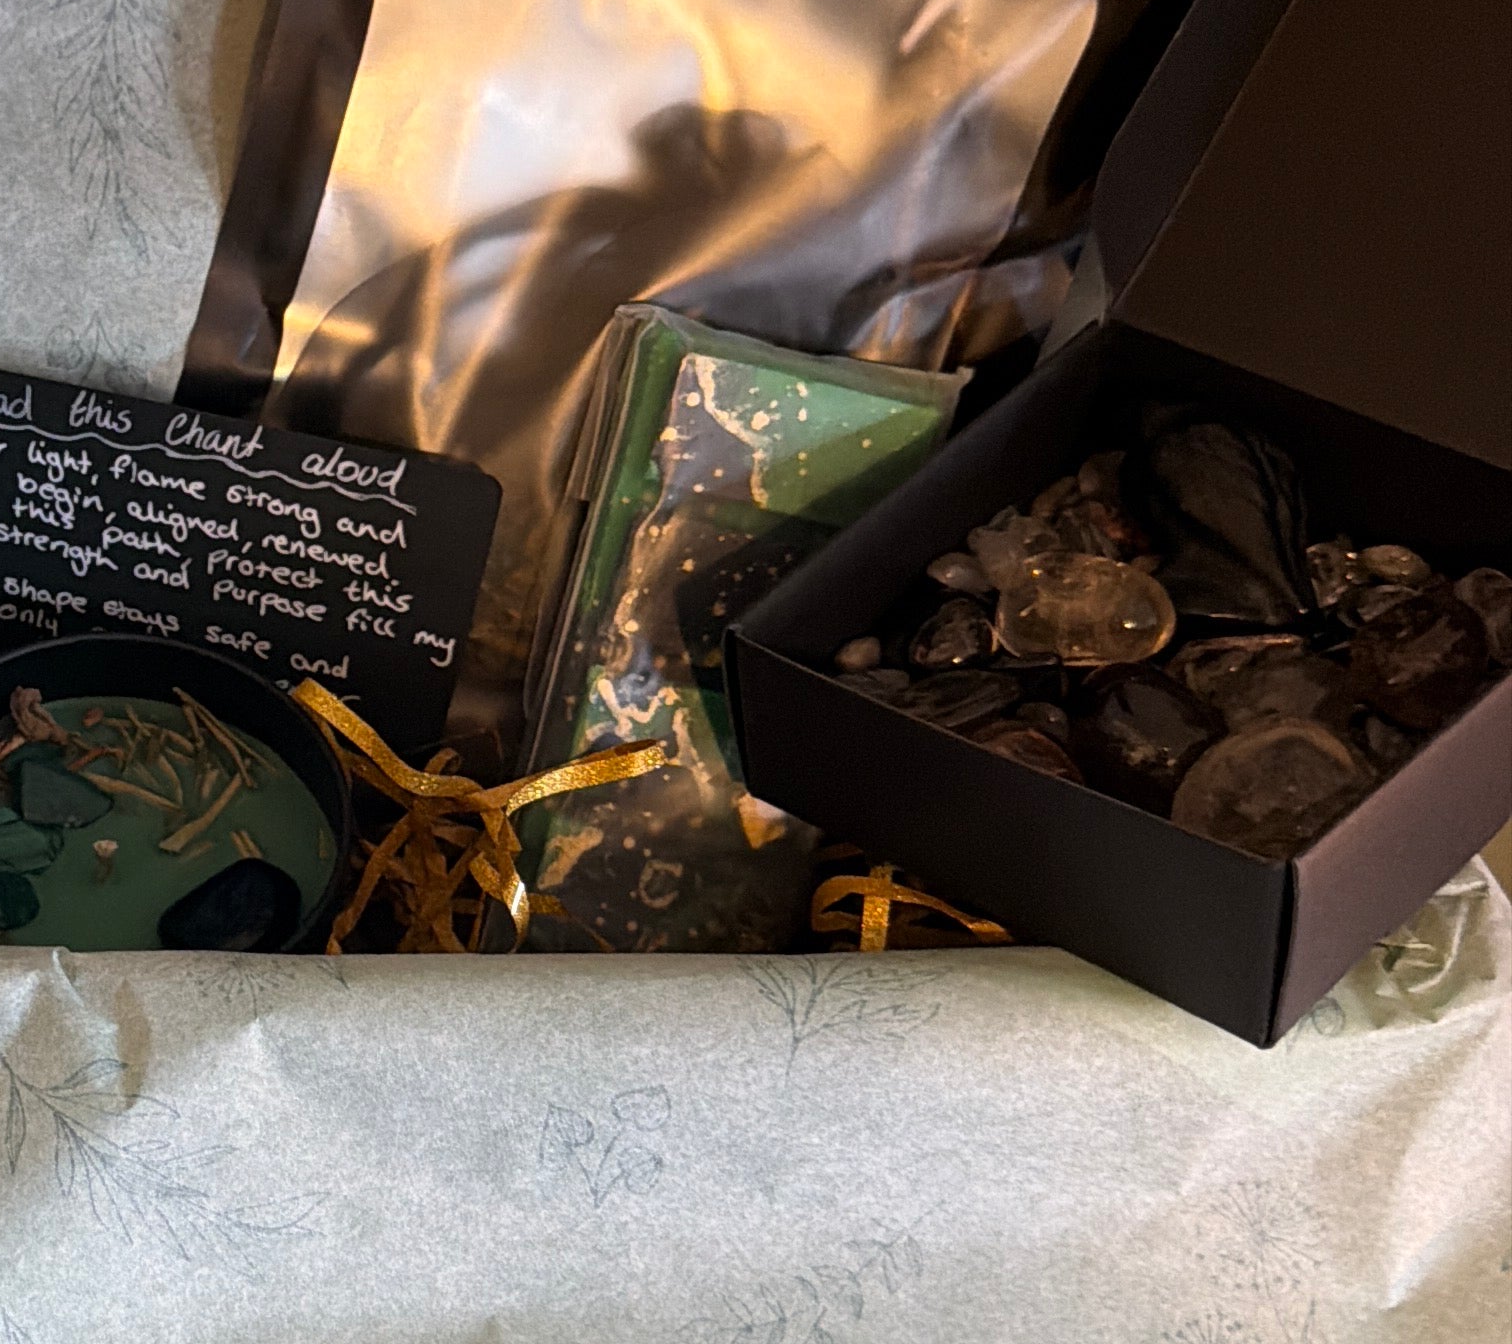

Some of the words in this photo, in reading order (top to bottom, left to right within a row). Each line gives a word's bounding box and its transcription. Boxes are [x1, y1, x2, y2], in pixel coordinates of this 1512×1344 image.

[69, 390, 132, 433] this
[165, 413, 264, 458] Chant
[301, 446, 407, 496] aloud
[109, 455, 206, 500] flame
[226, 484, 321, 538] strong
[337, 517, 407, 548] and
[12, 497, 75, 529] this
[343, 580, 413, 613] this
[3, 576, 88, 614] shape
[205, 625, 271, 660] safe
[290, 653, 350, 679] and
[134, 559, 191, 590] and
[413, 631, 456, 667] my
